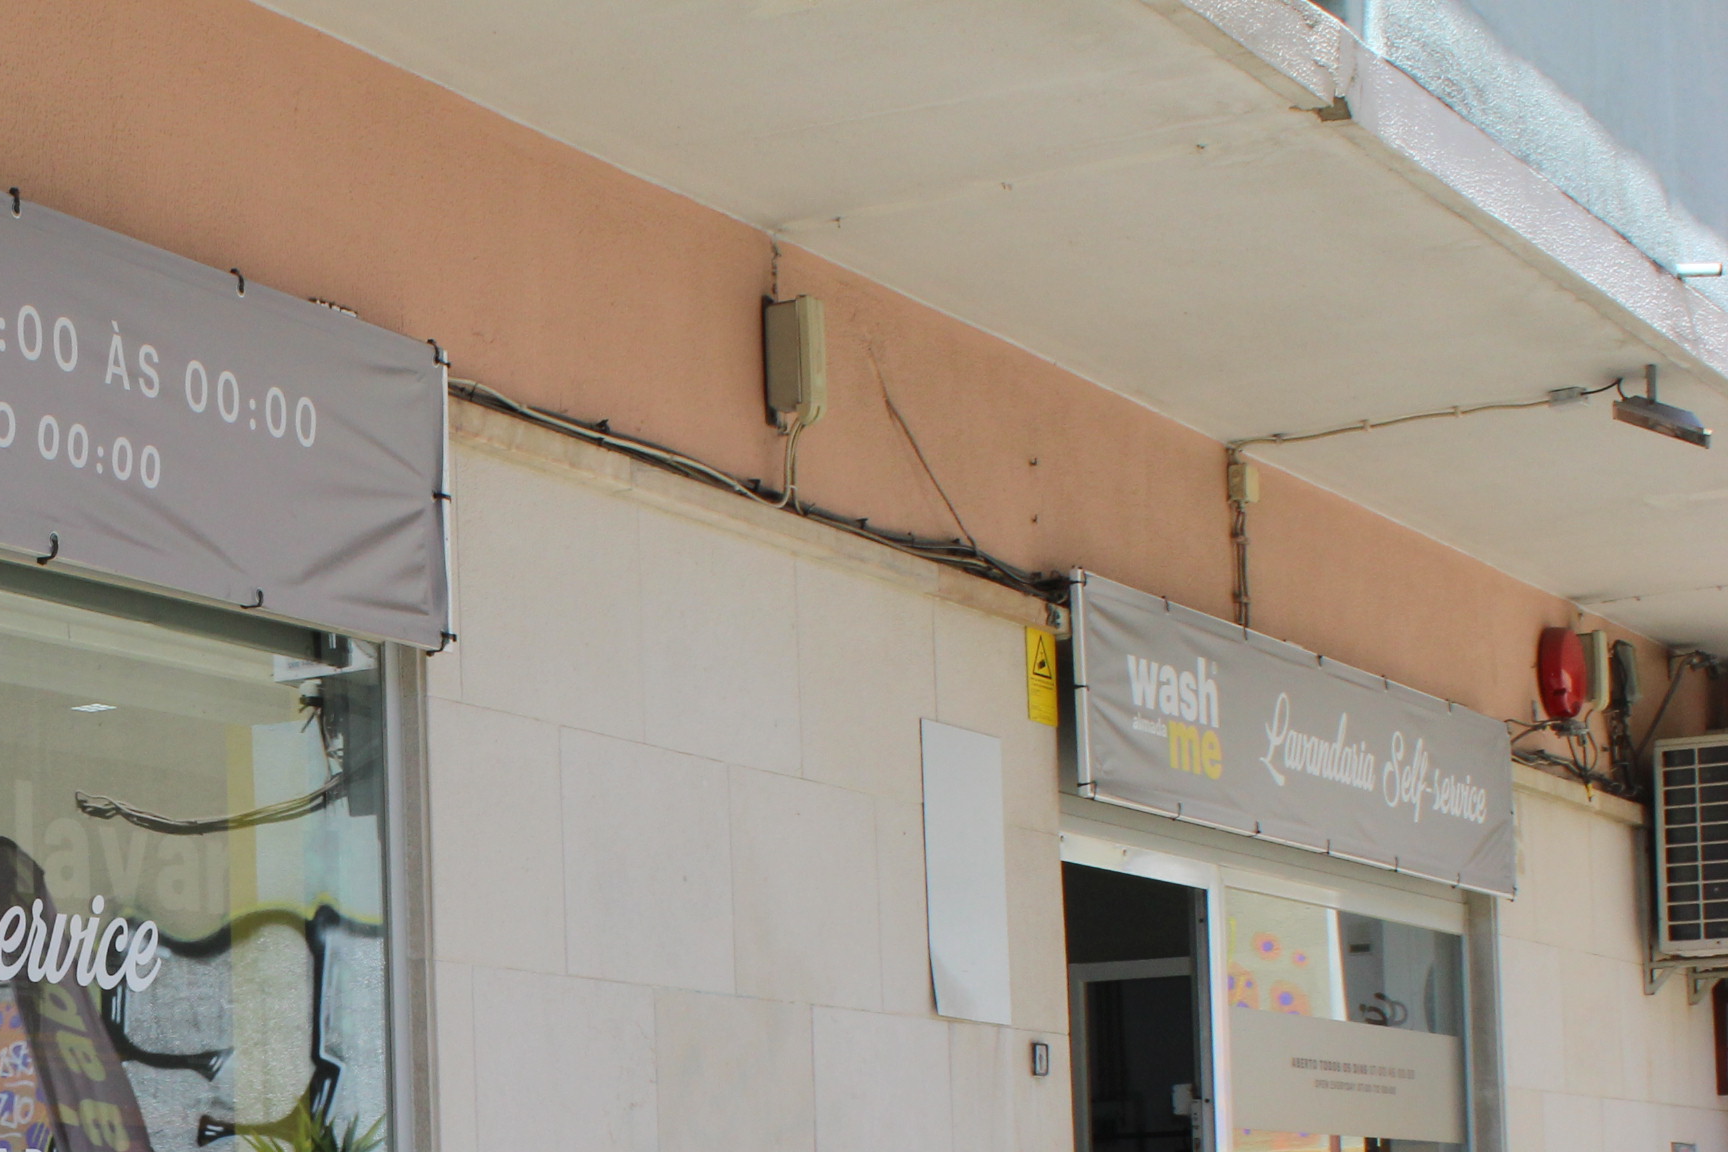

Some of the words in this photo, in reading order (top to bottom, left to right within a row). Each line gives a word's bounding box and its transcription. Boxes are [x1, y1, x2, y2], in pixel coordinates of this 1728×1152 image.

[105, 319, 161, 398] ÀS
[184, 360, 317, 448] 00:00
[38, 414, 162, 489] 00:00
[1127, 654, 1221, 729] wash
[1132, 712, 1168, 738] almada
[1168, 720, 1223, 781] me
[1259, 692, 1375, 787] Lavandaria
[1382, 731, 1487, 824] Self-service
